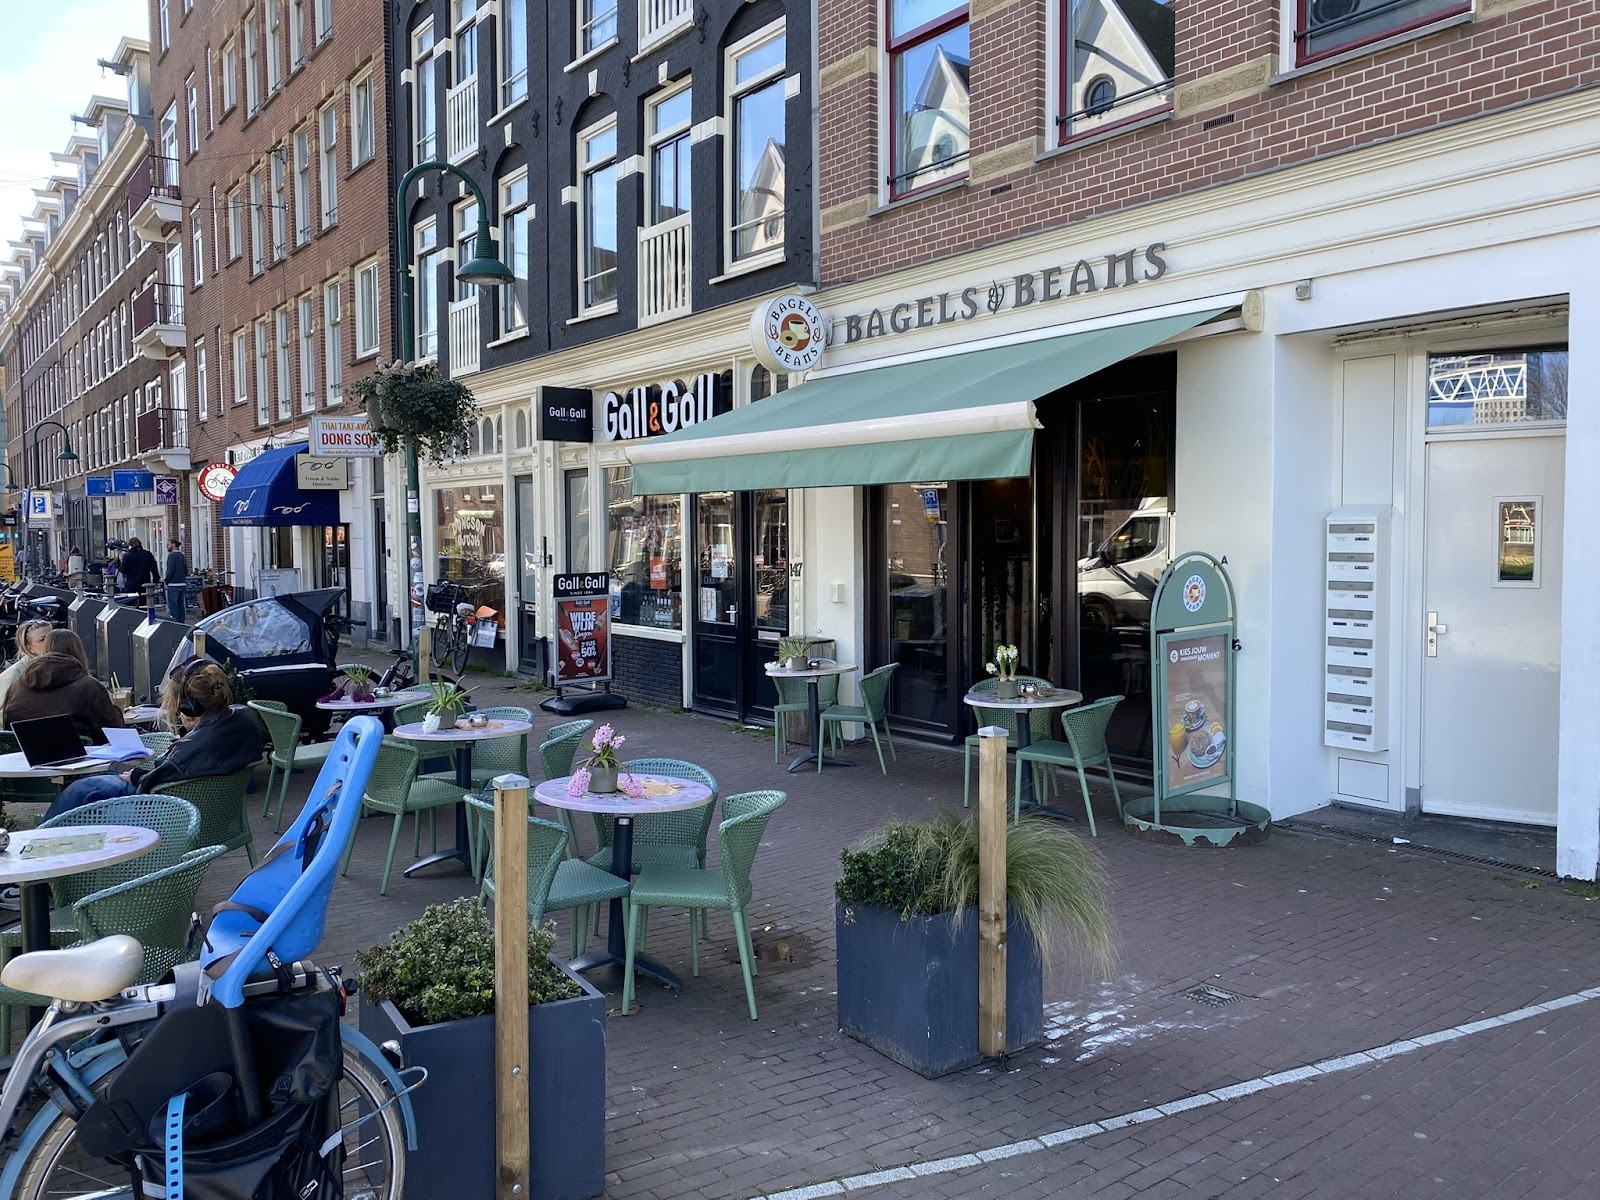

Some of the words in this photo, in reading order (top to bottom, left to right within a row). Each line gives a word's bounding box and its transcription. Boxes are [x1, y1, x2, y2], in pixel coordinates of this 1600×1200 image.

[844, 287, 977, 344] BAGELS
[1012, 242, 1167, 309] BEANS
[771, 298, 819, 324] BAGELS
[775, 346, 818, 366] BEANS
[549, 406, 566, 417] Gall
[569, 407, 586, 419] Gall
[603, 386, 648, 441] Gall
[661, 373, 714, 433] Gall
[321, 422, 337, 430] THAI
[321, 433, 352, 445] DONG
[35, 498, 43, 507] P
[452, 516, 486, 537] DONGSON
[789, 562, 803, 577] 147
[558, 576, 579, 590] Gall
[584, 575, 605, 589] Gall
[569, 611, 597, 622] WILDE
[571, 621, 595, 631] WIJN
[1180, 647, 1191, 656] KIES
[1191, 645, 1207, 655] JOUW
[1197, 651, 1220, 661] MOMENT
